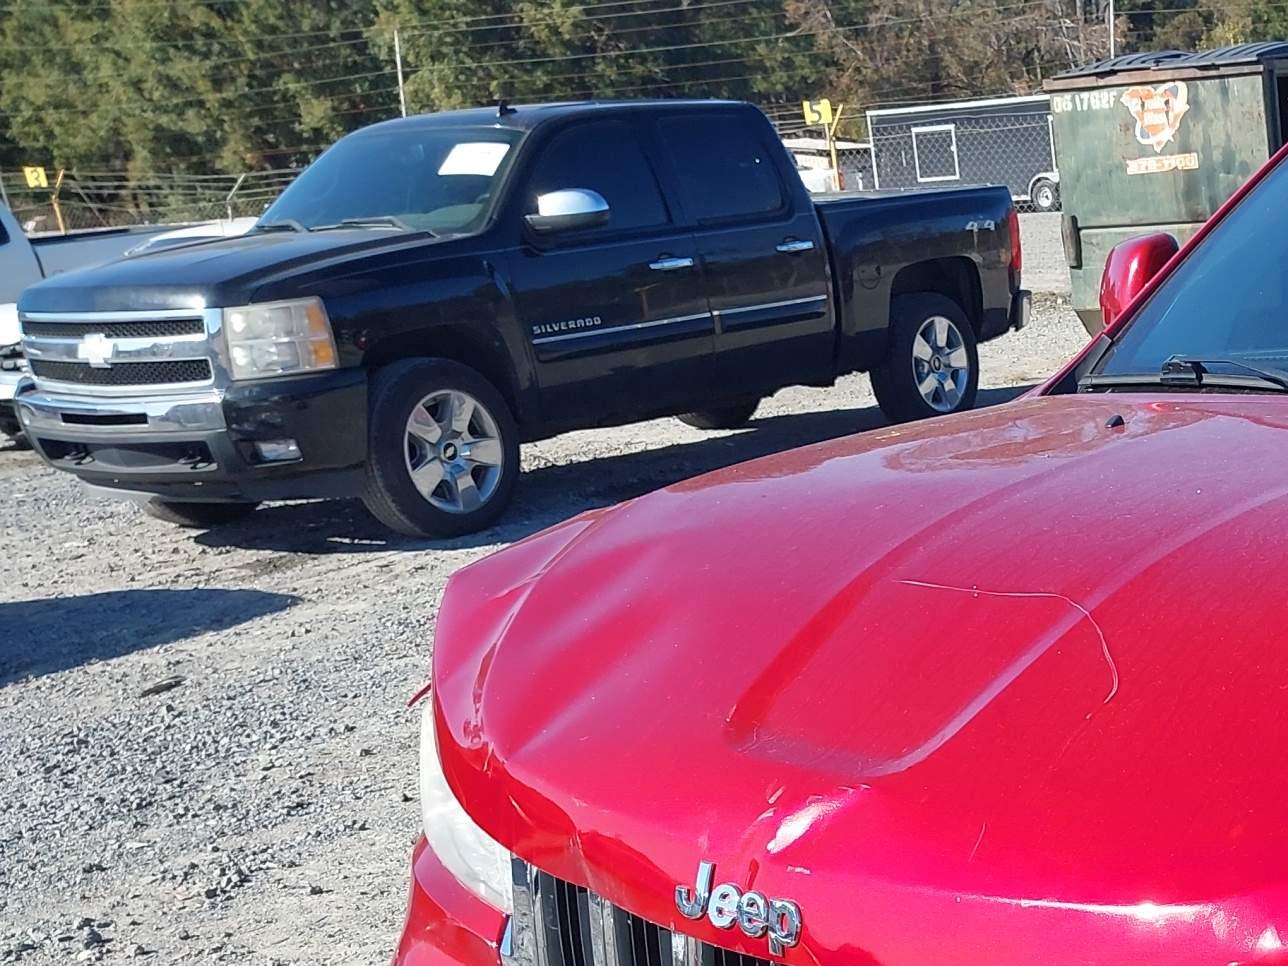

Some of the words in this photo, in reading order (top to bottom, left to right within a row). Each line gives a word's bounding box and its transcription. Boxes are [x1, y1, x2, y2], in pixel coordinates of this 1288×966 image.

[809, 99, 822, 124] 5
[532, 316, 602, 335] SILVERADO
[675, 859, 802, 957] Jeep
